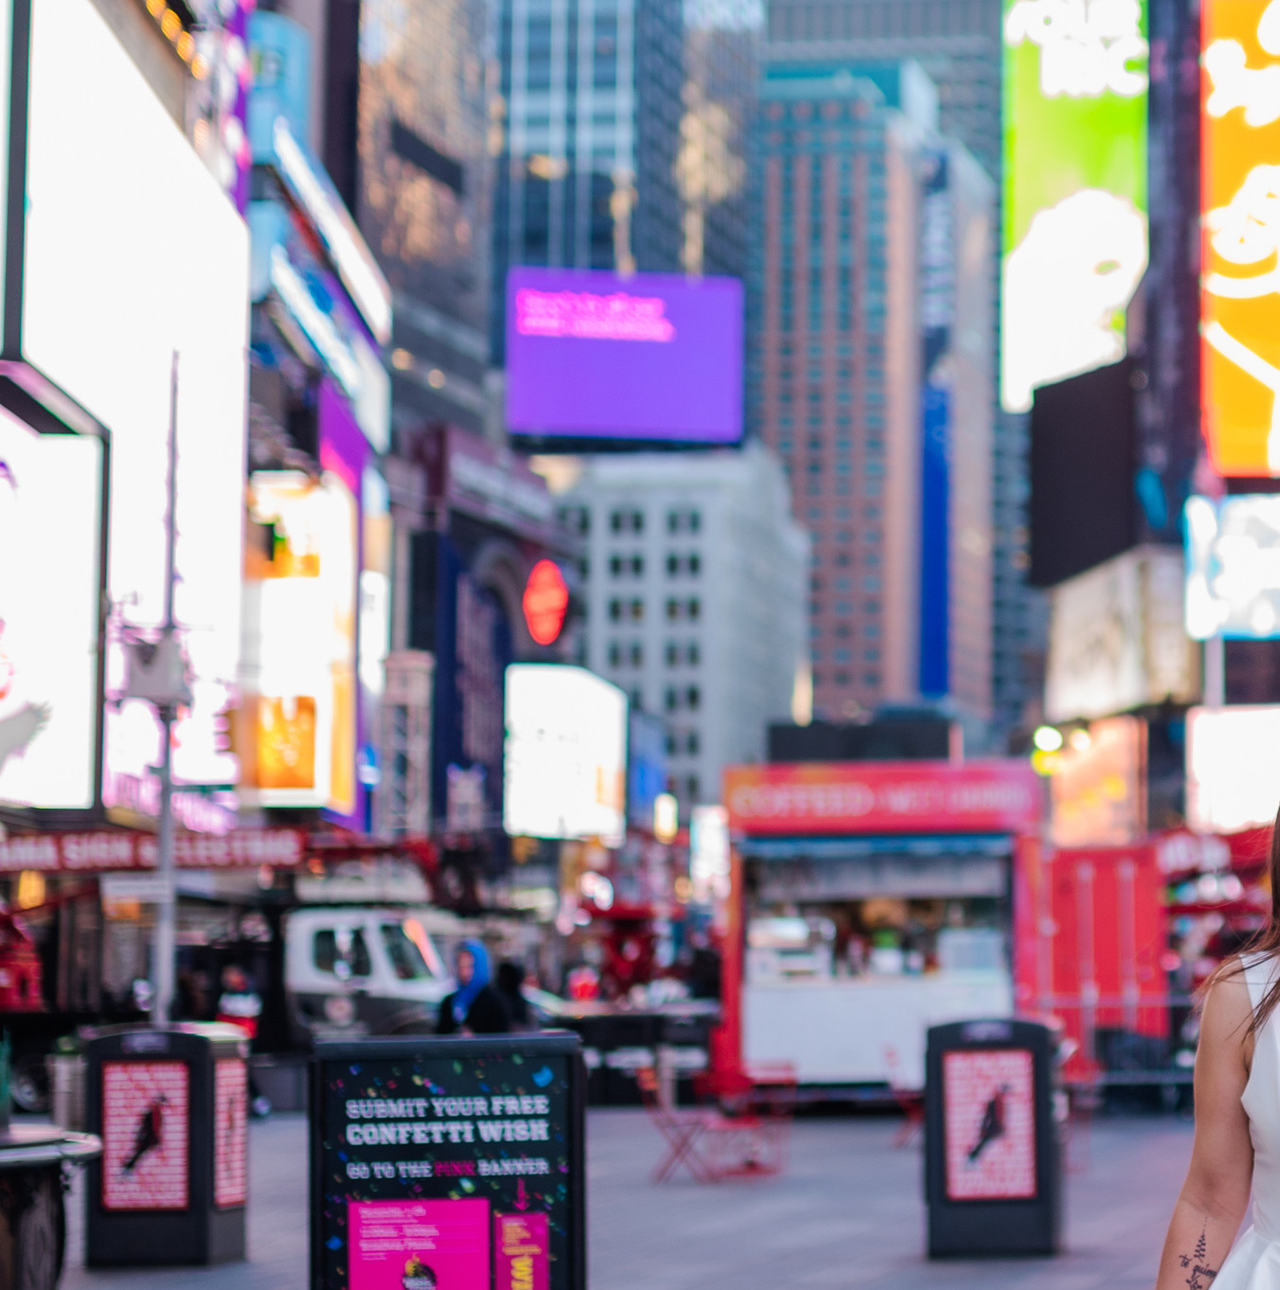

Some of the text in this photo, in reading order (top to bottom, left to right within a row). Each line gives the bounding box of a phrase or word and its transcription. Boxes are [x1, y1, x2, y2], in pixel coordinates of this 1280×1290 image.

[345, 1094, 549, 1118] SUBMIT YOUR FREE
[345, 1118, 549, 1145] CONFETTI WISH
[346, 1158, 549, 1179] GO TO THE PINK BANNER
